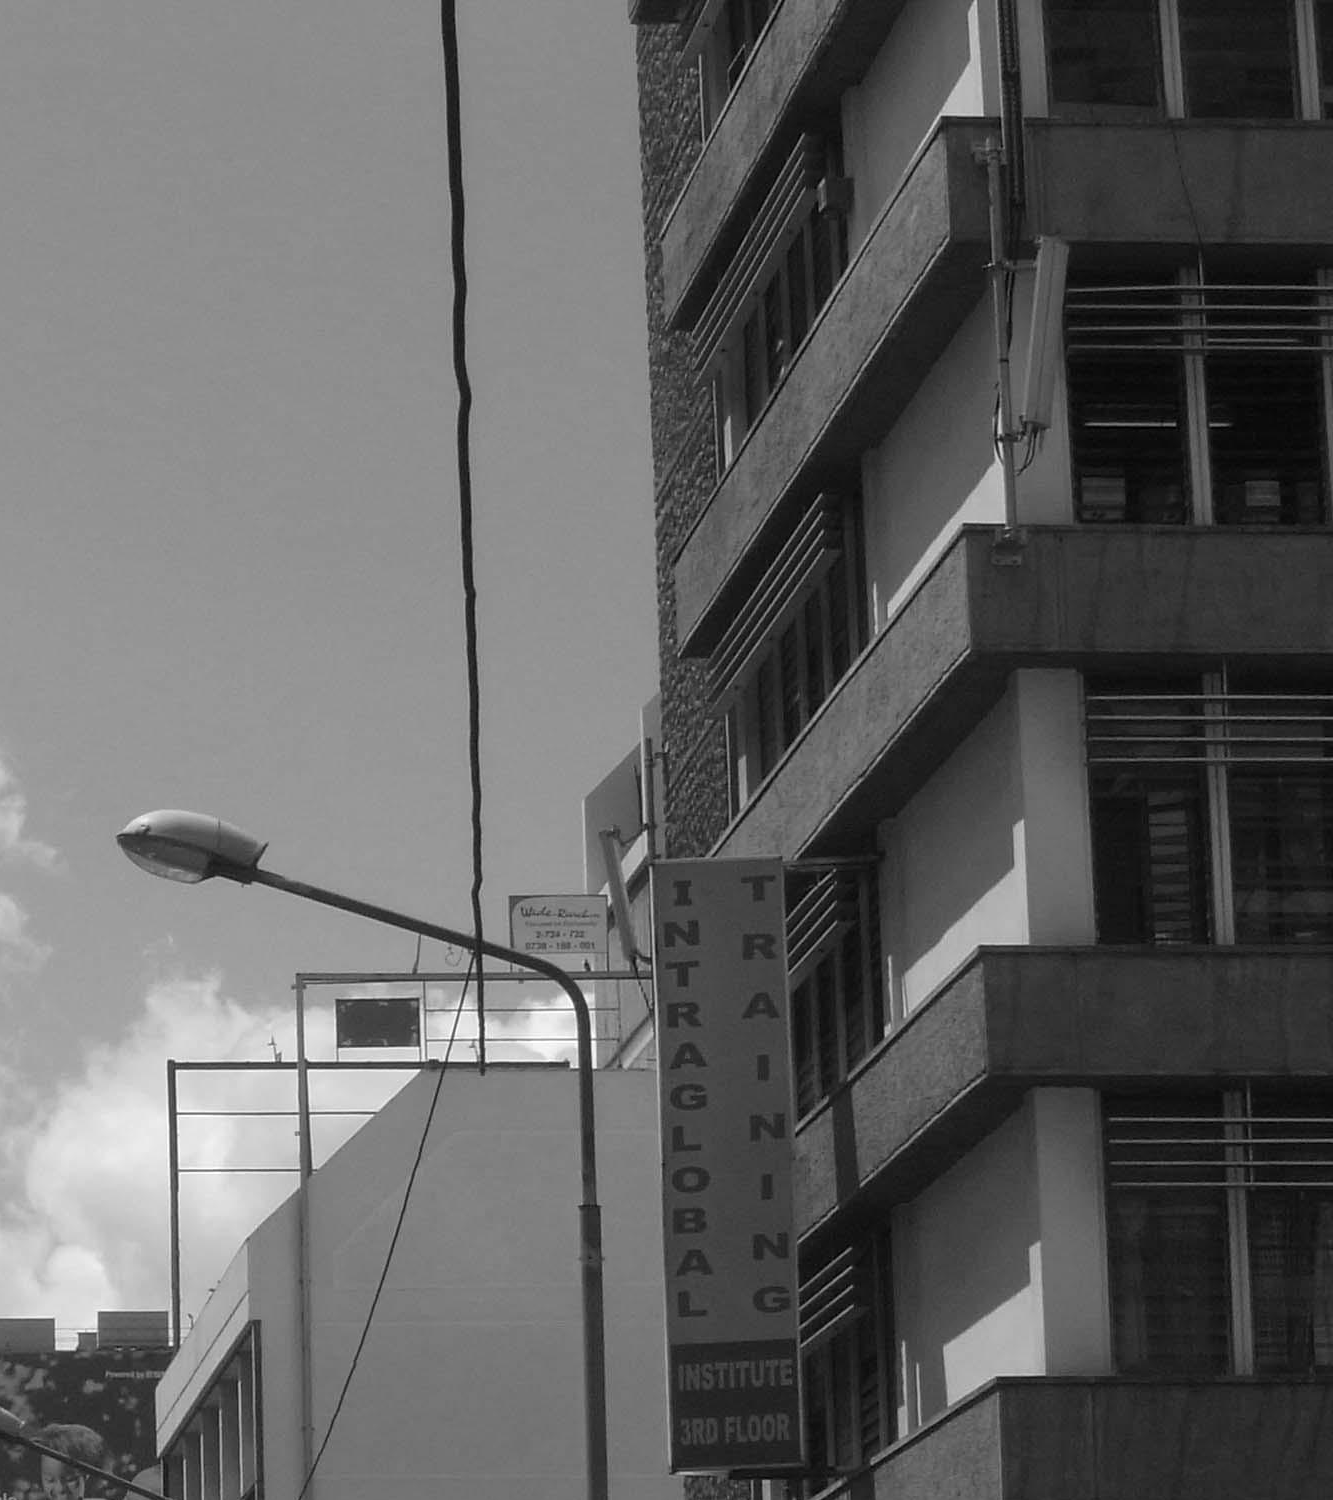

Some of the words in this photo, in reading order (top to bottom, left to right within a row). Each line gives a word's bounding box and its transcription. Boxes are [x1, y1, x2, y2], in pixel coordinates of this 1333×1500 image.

[664, 880, 713, 1319] INTRAGLOBAL
[740, 874, 791, 1314] TRAINING
[678, 1358, 794, 1391] INSTITUTE
[680, 1416, 719, 1446] 3RD
[724, 1415, 791, 1444] FLOOR
